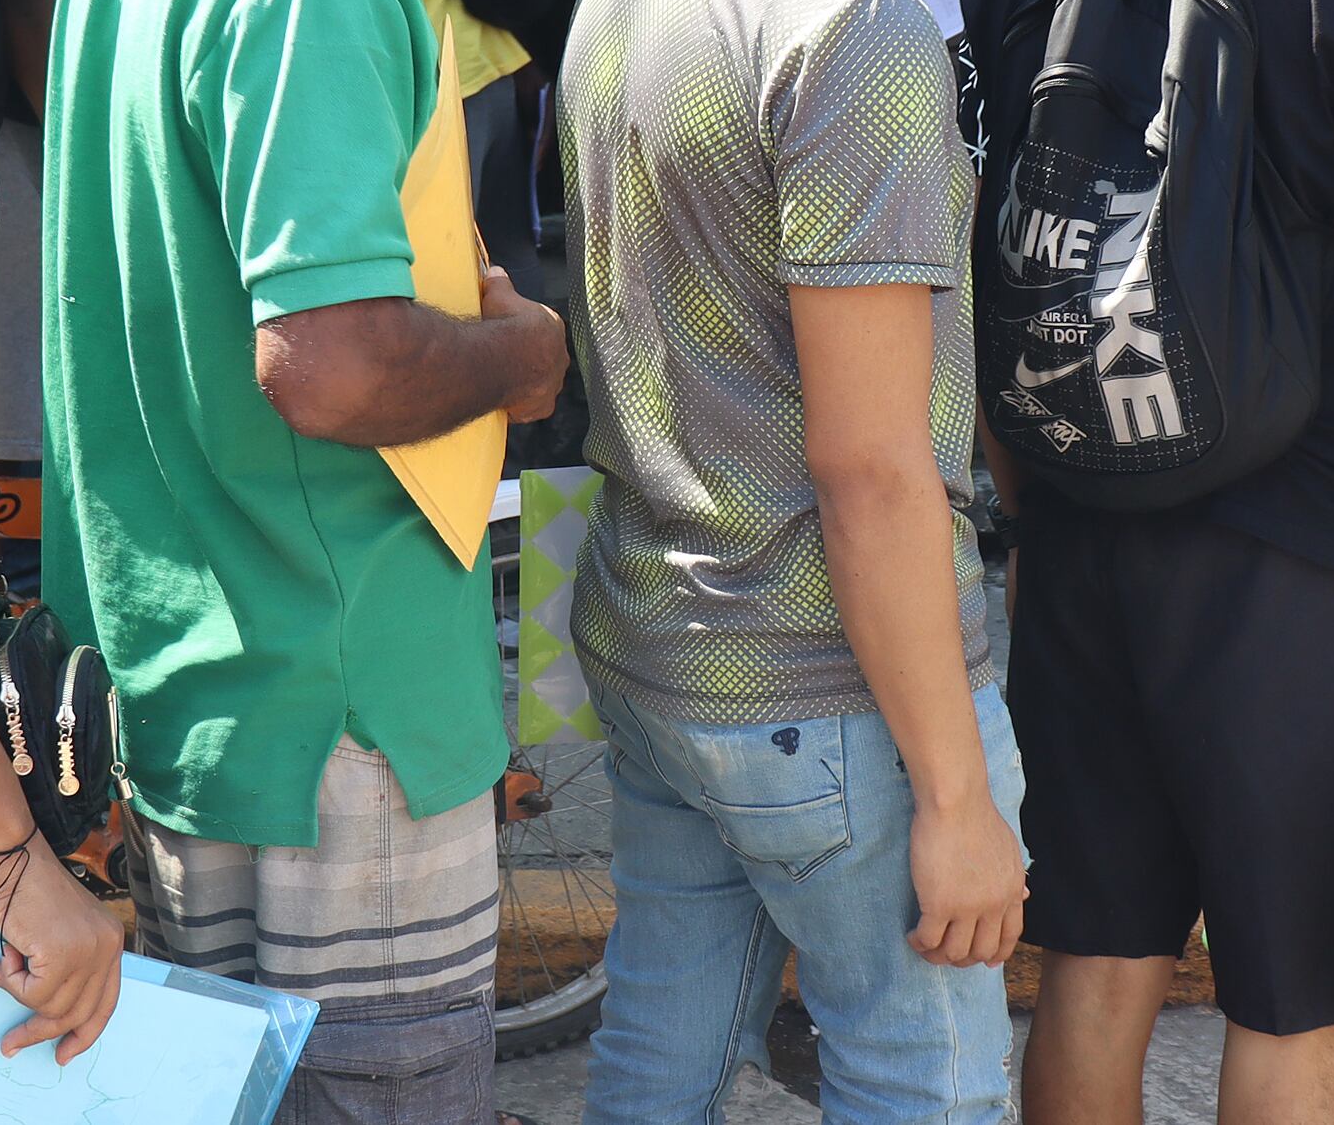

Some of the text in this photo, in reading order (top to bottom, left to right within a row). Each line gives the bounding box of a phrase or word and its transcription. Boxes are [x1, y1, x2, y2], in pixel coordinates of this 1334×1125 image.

[997, 153, 1098, 279] NIKE
[1041, 311, 1061, 322] AIR
[1089, 187, 1187, 446] NIKE
